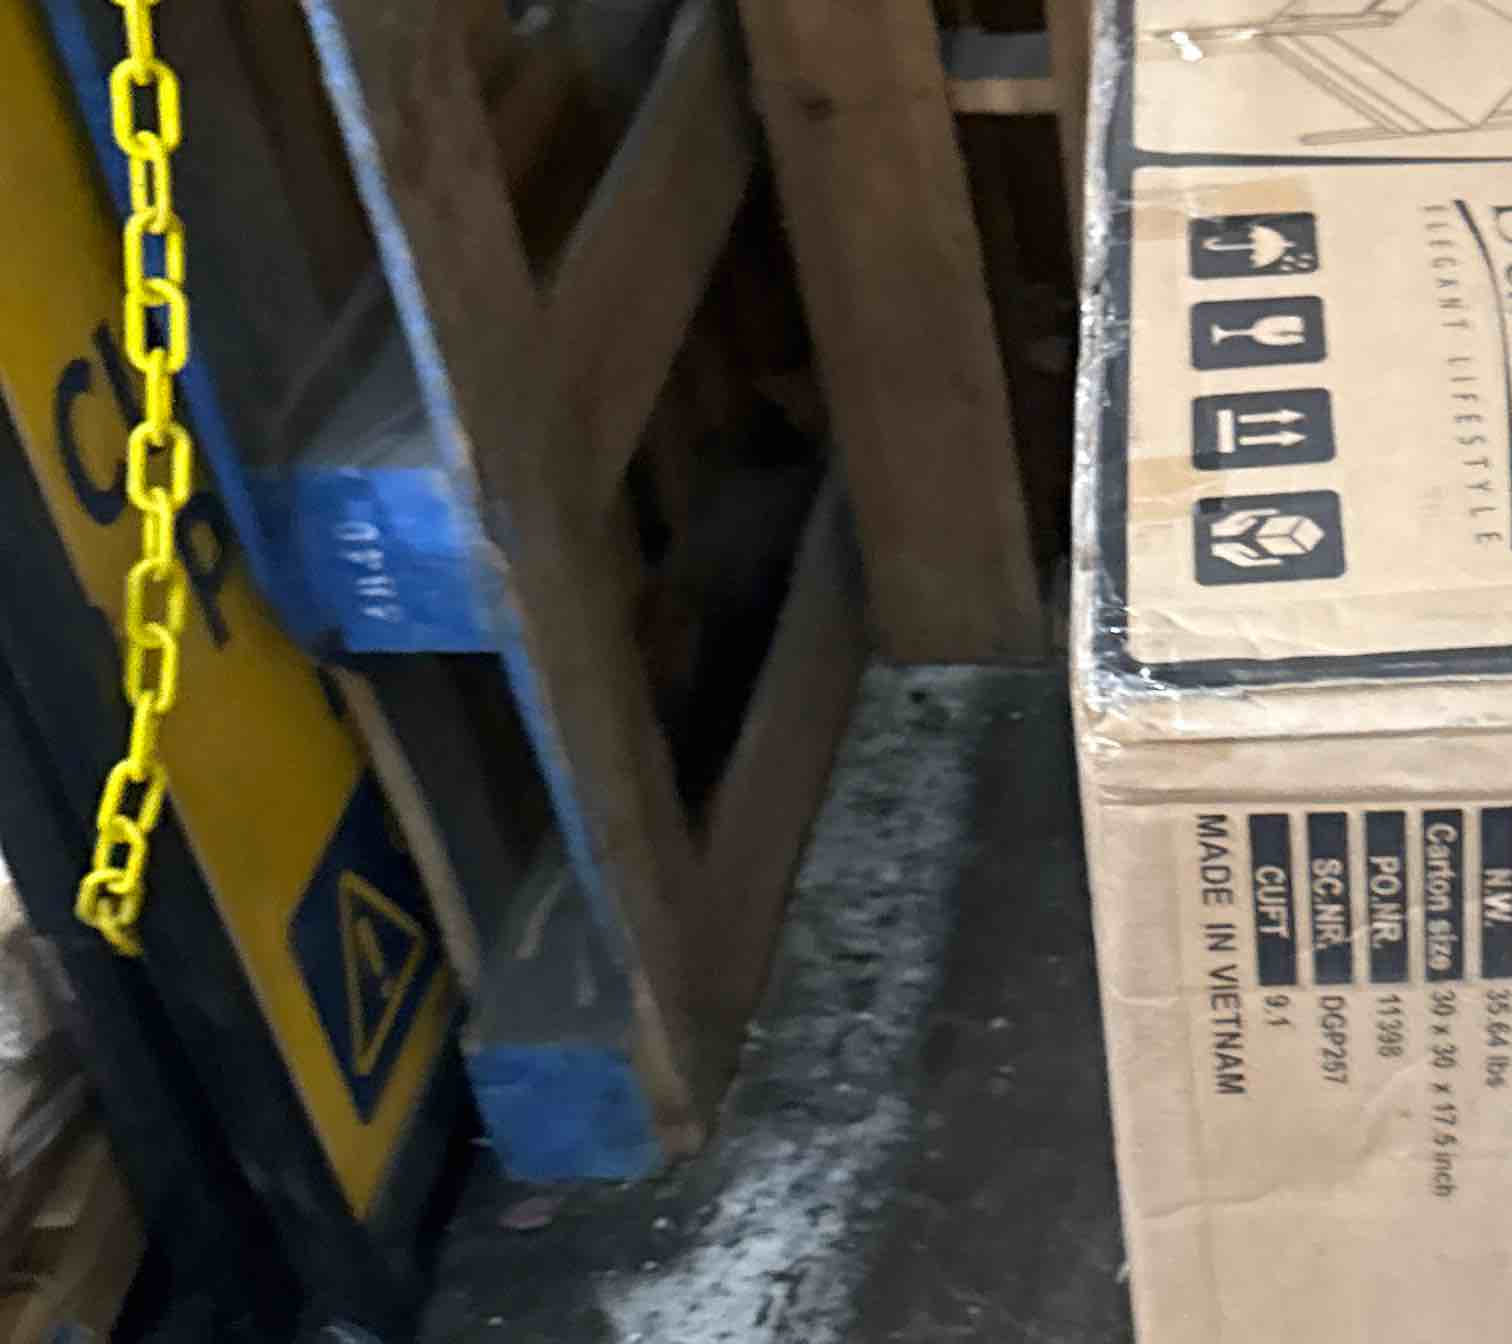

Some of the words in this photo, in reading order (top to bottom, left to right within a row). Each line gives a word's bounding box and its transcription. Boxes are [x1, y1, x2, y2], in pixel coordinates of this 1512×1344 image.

[1422, 202, 1470, 330] ELEGANT
[1447, 354, 1503, 545] LIFESTYLE
[1195, 812, 1236, 906] MADE
[1422, 823, 1458, 912] Carton
[1202, 922, 1237, 953] IN
[1252, 864, 1291, 940] CUFT
[1310, 857, 1346, 950] SC.NR.
[1368, 856, 1404, 950] PO.NR.
[1425, 918, 1457, 971] size
[1207, 962, 1250, 1096] VIETNAM
[1262, 994, 1290, 1027] 9.1
[1429, 988, 1456, 1020] 30
[1485, 1056, 1512, 1088] lbs
[1427, 1152, 1458, 1199] inch
